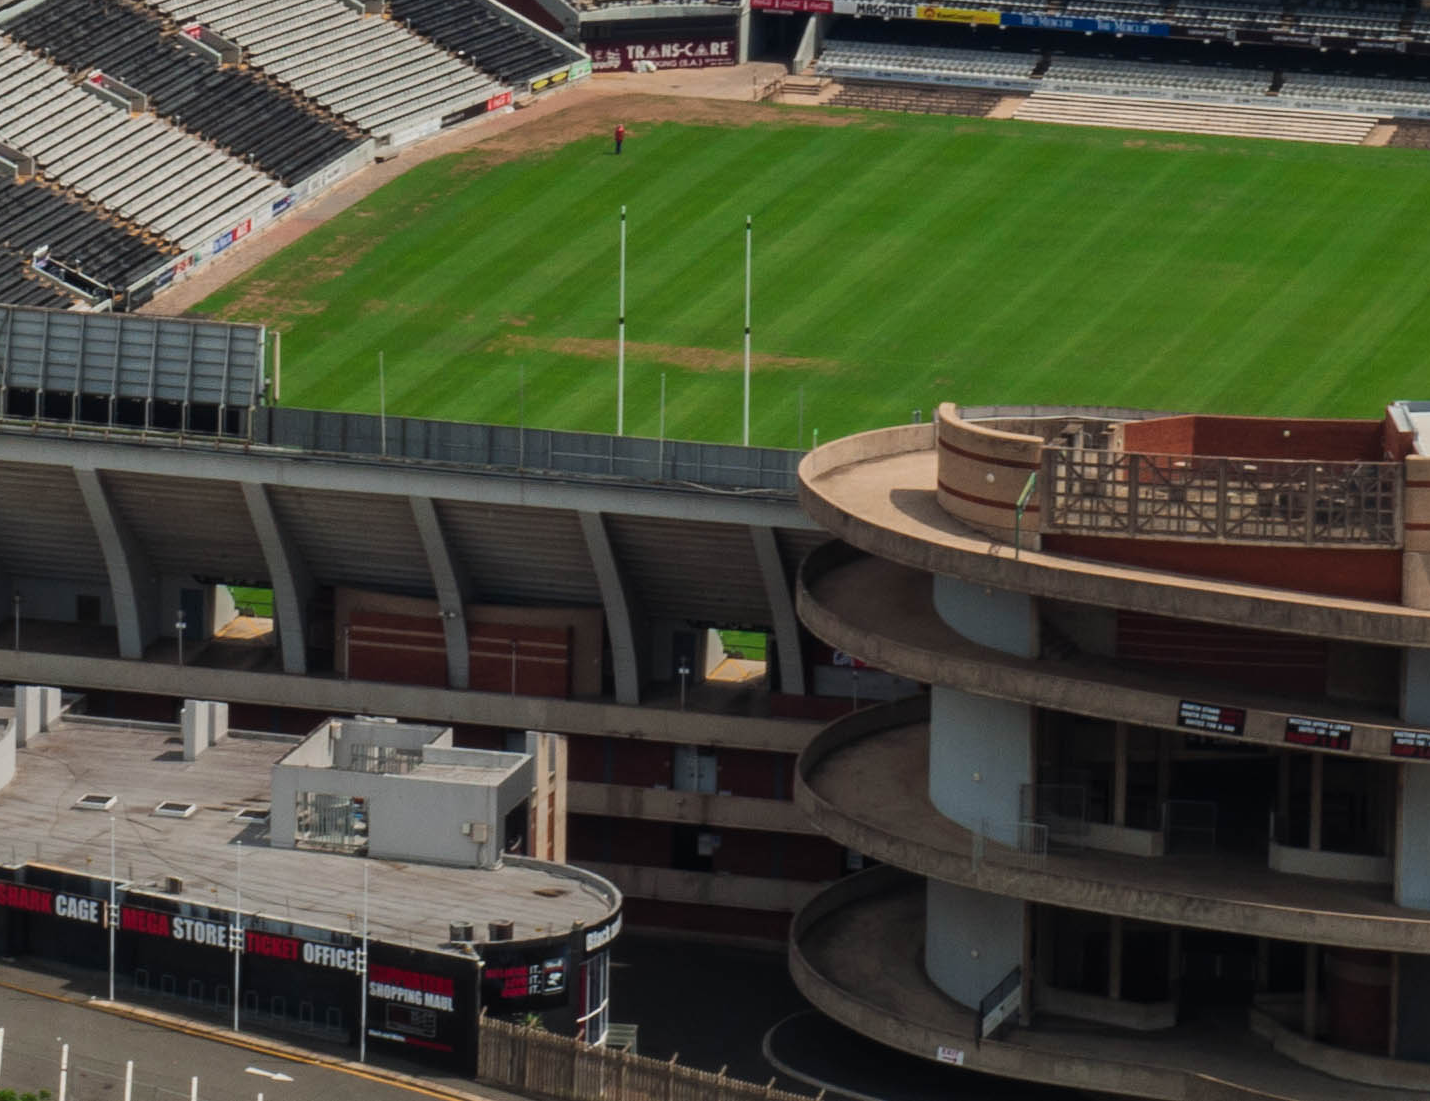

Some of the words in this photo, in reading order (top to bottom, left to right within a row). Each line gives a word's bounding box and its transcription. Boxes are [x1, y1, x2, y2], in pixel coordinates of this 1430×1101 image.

[856, 4, 913, 18] MASONITE
[626, 41, 729, 59] TRANS-CARE
[55, 894, 99, 923] CAGE
[122, 907, 170, 937] MEGA
[173, 917, 227, 948] STORE
[247, 932, 300, 960] TICKET
[303, 942, 355, 971] OFFICE
[369, 981, 421, 1005] SHOPPING
